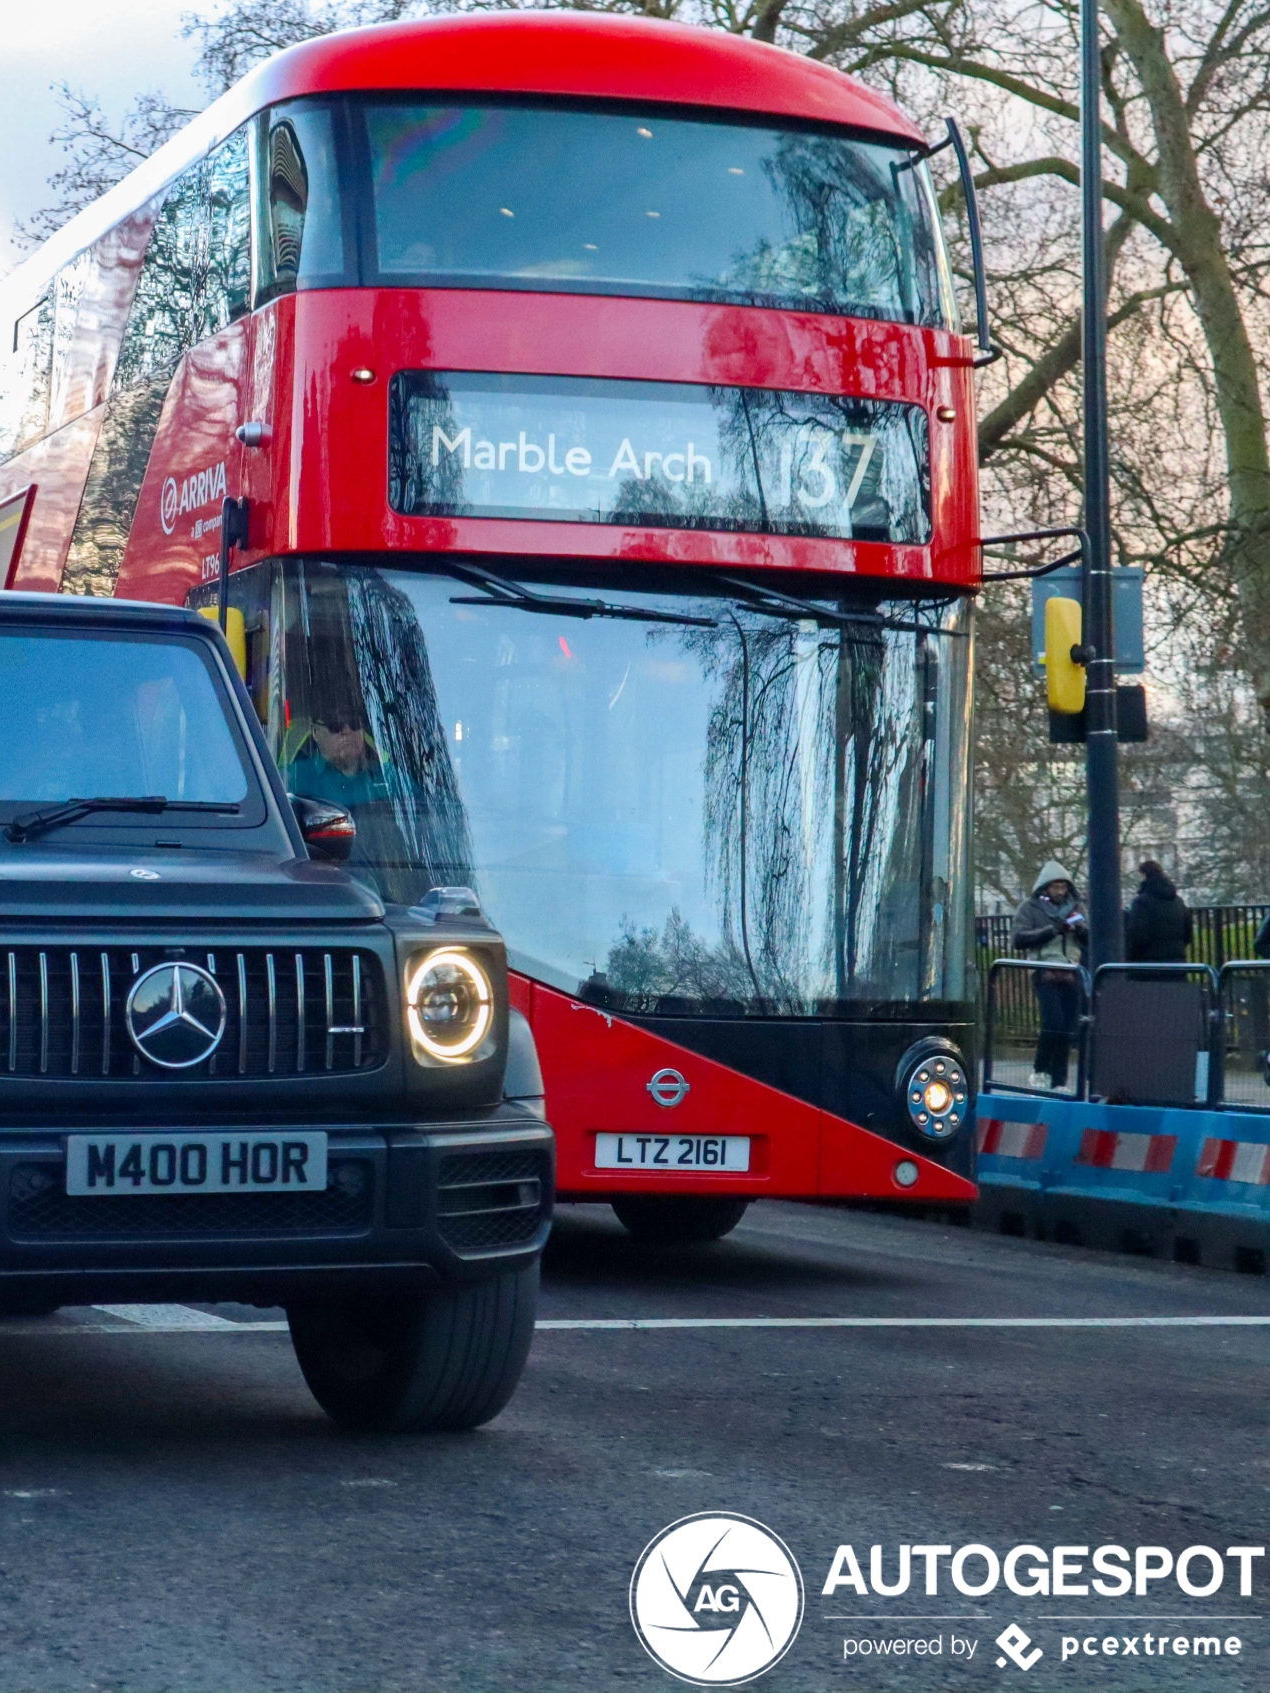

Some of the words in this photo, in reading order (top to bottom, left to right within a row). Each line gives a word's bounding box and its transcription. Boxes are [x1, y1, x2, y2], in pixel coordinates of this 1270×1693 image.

[431, 425, 592, 478] Marble
[609, 437, 712, 484] Arch
[781, 428, 878, 511] 137
[179, 462, 226, 515] ARRIVA
[203, 515, 223, 532] compan
[87, 1142, 207, 1187] M400
[221, 1140, 309, 1185] HOR
[617, 1137, 670, 1164] LTZ
[677, 1139, 727, 1165] 2161
